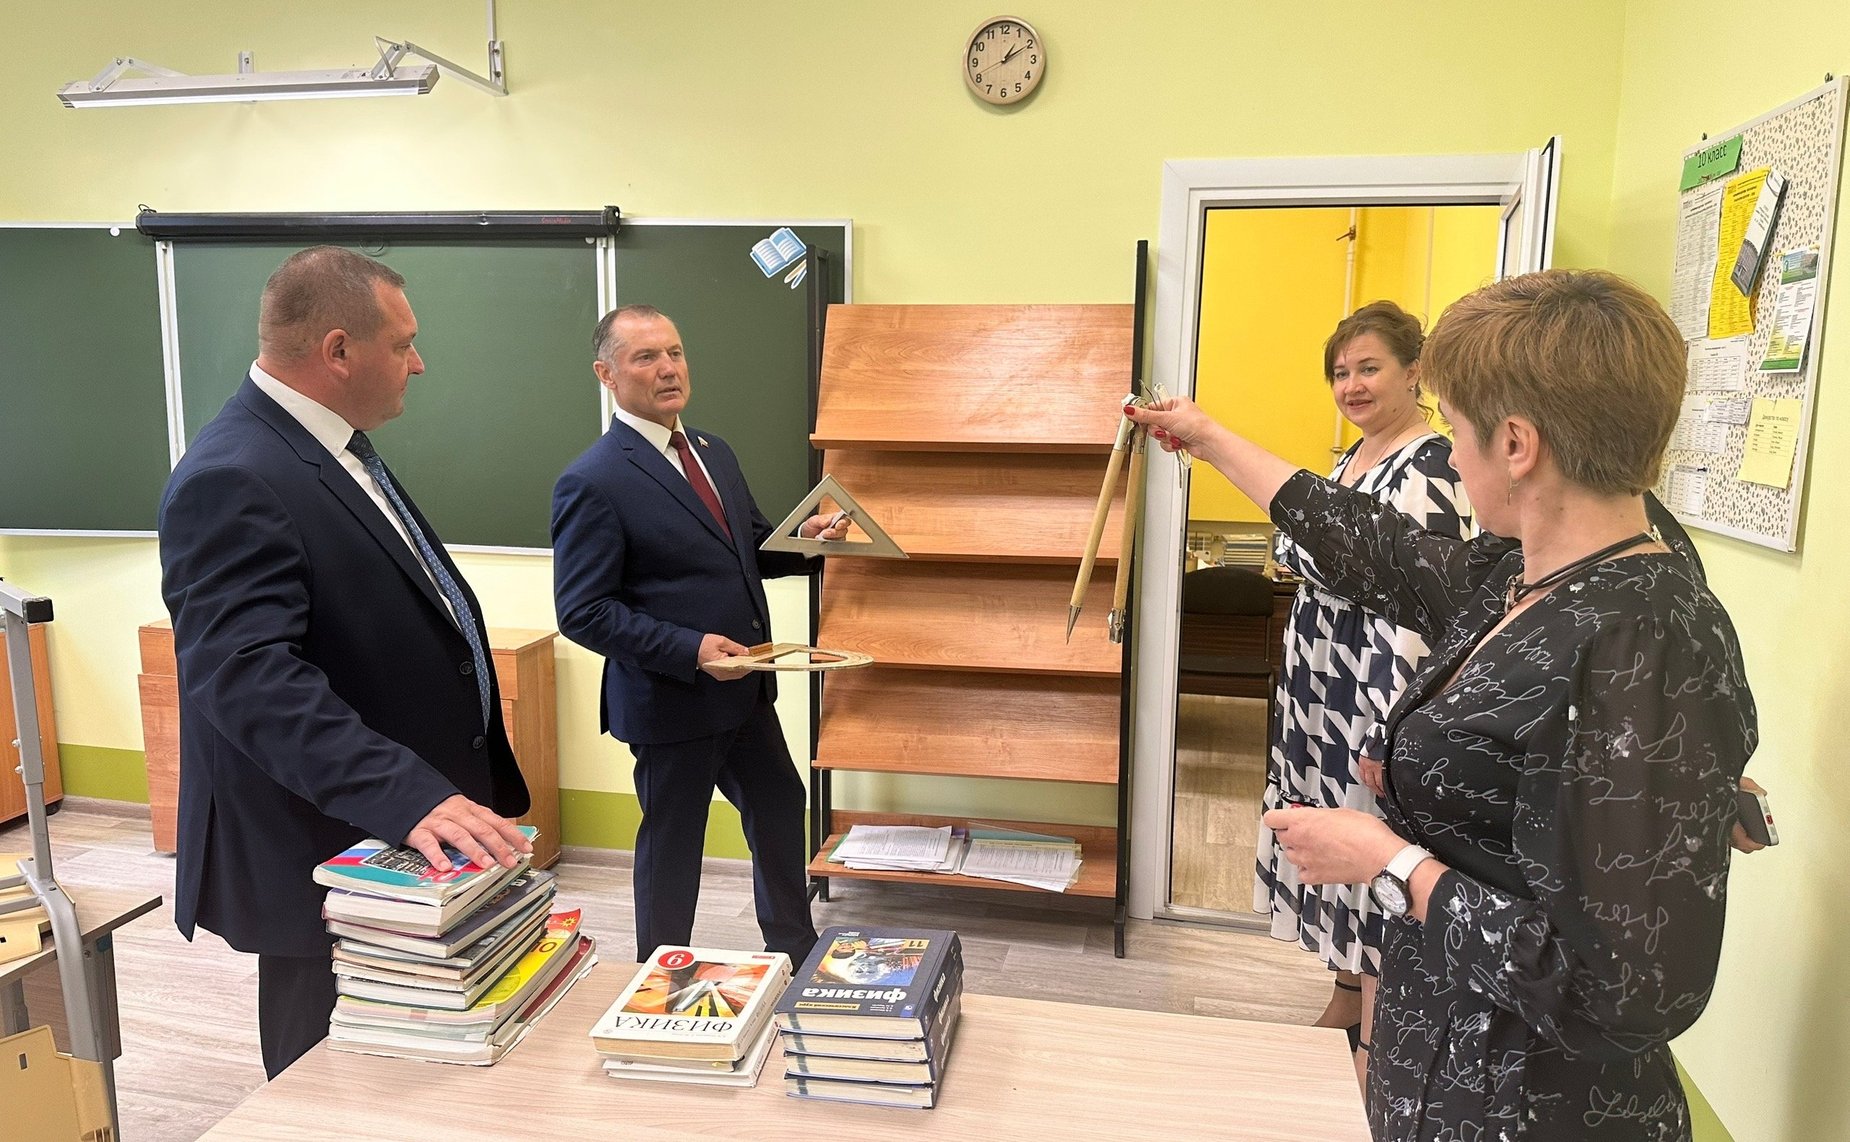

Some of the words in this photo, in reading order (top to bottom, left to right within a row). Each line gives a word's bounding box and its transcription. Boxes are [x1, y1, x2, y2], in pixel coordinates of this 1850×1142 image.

[986, 30, 995, 39] 11
[1000, 25, 1010, 35] 12
[1016, 28, 1021, 38] 1
[974, 42, 985, 51] 10
[1026, 39, 1033, 49] 2
[972, 58, 979, 68] 9
[1030, 54, 1037, 64] 3
[975, 73, 982, 83] 8
[1024, 70, 1031, 80] 4
[985, 84, 992, 94] 7
[1000, 88, 1007, 98] 6
[1015, 83, 1022, 93] 5
[1698, 151, 1706, 168] 10
[1707, 144, 1727, 164] класс
[909, 940, 924, 948] 11
[666, 953, 686, 966] 9
[802, 987, 907, 1003] физика
[615, 1015, 733, 1033] ФИЗИКА
